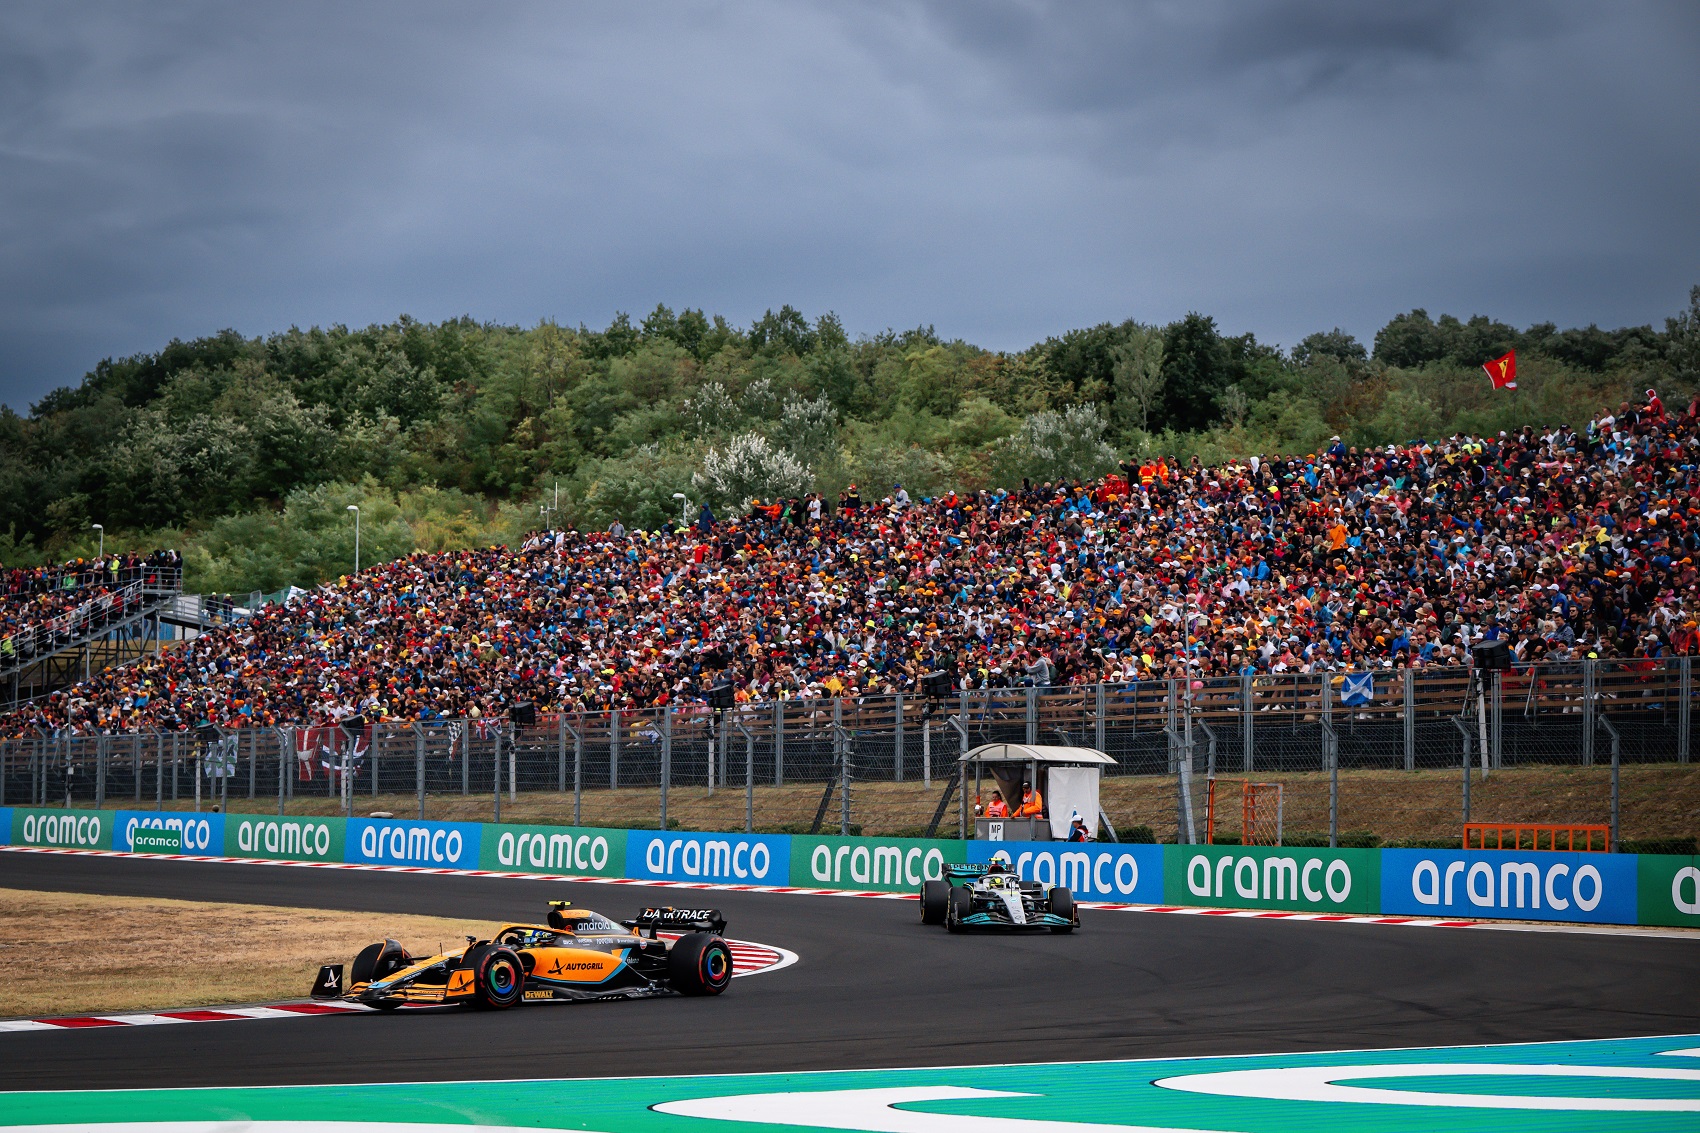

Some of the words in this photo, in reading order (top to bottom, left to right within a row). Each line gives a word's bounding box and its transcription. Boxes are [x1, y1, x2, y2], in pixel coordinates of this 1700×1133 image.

[24, 815, 100, 845] aramco
[136, 836, 179, 847] aramco
[239, 821, 329, 856] aramco
[361, 826, 462, 863] aramco
[991, 824, 1002, 834] MP
[498, 832, 608, 871] aramco
[646, 839, 769, 878] aramco
[812, 845, 944, 886] aramco
[1188, 855, 1351, 903] aramco
[1412, 860, 1602, 911] aramco
[577, 918, 611, 931] android
[565, 962, 604, 971] AUTOGRILL
